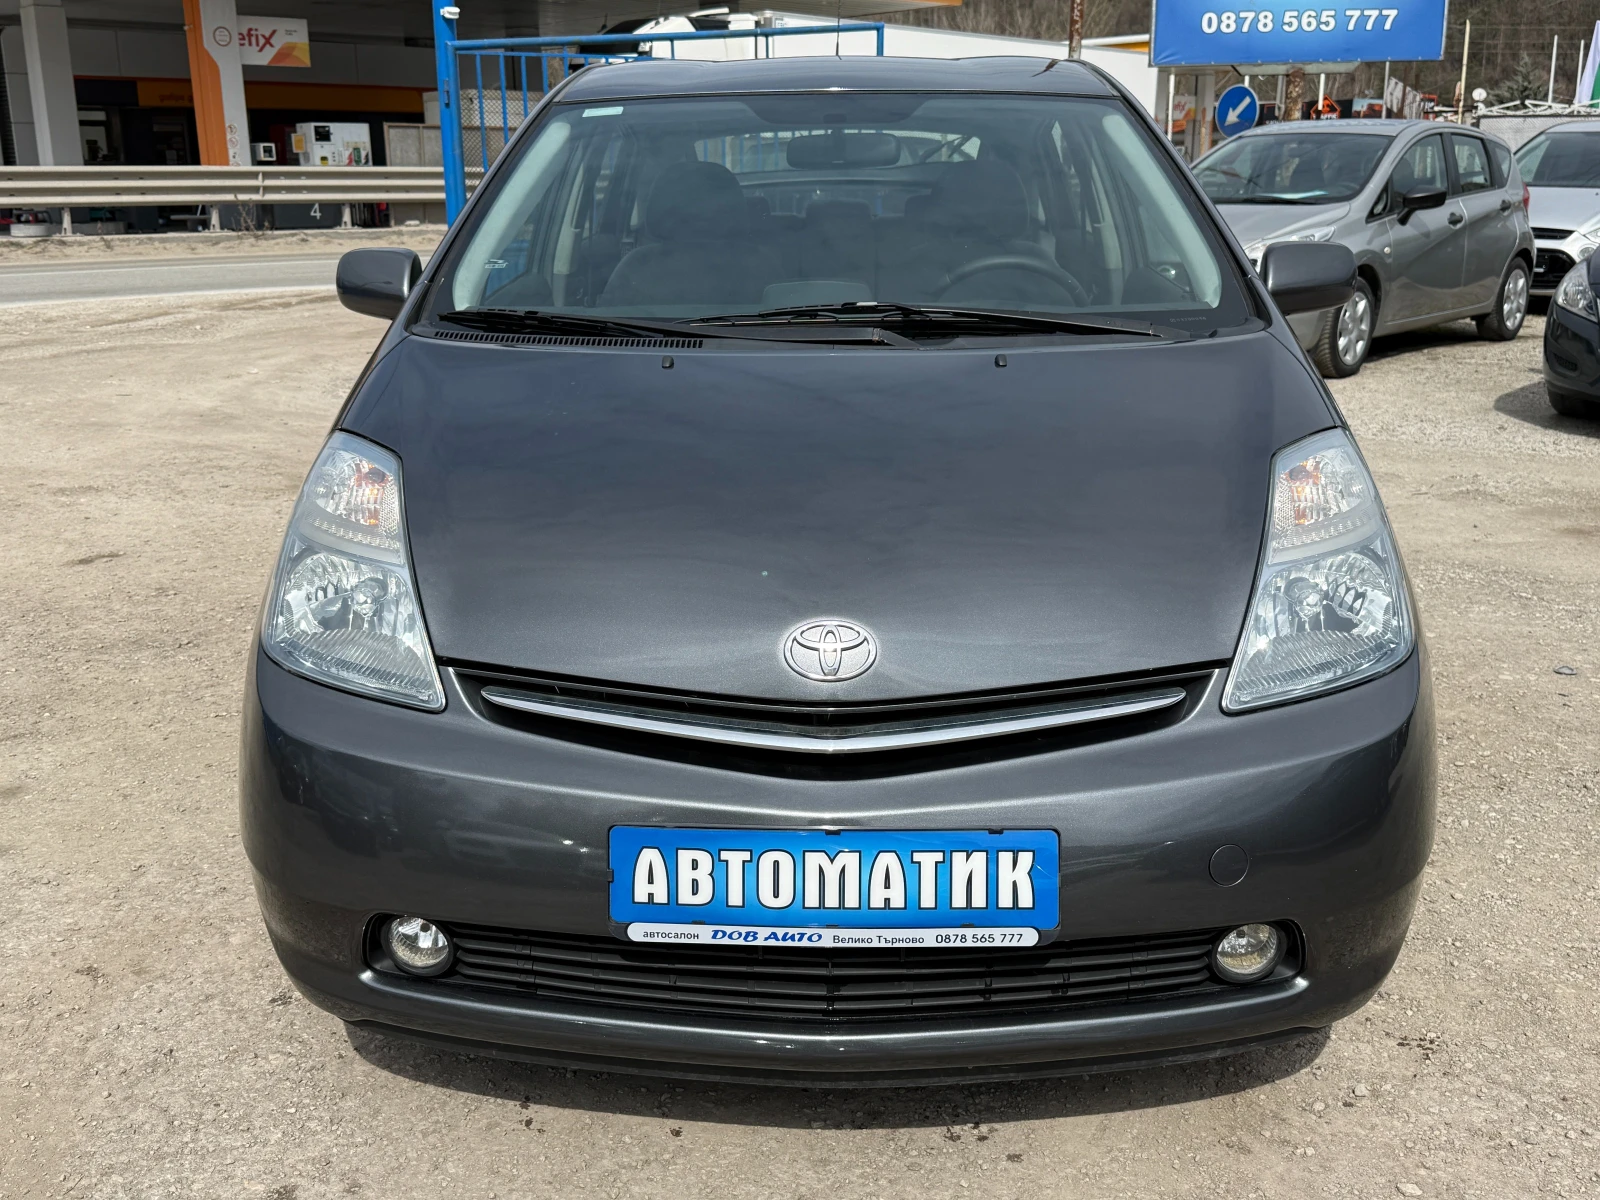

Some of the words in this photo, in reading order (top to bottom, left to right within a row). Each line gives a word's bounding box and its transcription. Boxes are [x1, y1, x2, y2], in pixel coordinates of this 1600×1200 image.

[1201, 11, 1274, 34] 0878
[1281, 10, 1336, 33] 565
[1344, 8, 1399, 31] 777
[238, 27, 278, 53] efix
[310, 203, 322, 220] 4
[632, 846, 1036, 910] АВТОМАТИК
[642, 930, 699, 940] автосалон
[832, 934, 873, 944] Велико
[876, 935, 925, 946] Търново
[935, 934, 968, 944] 0878
[971, 934, 995, 943] 565
[1000, 933, 1023, 943] 777
